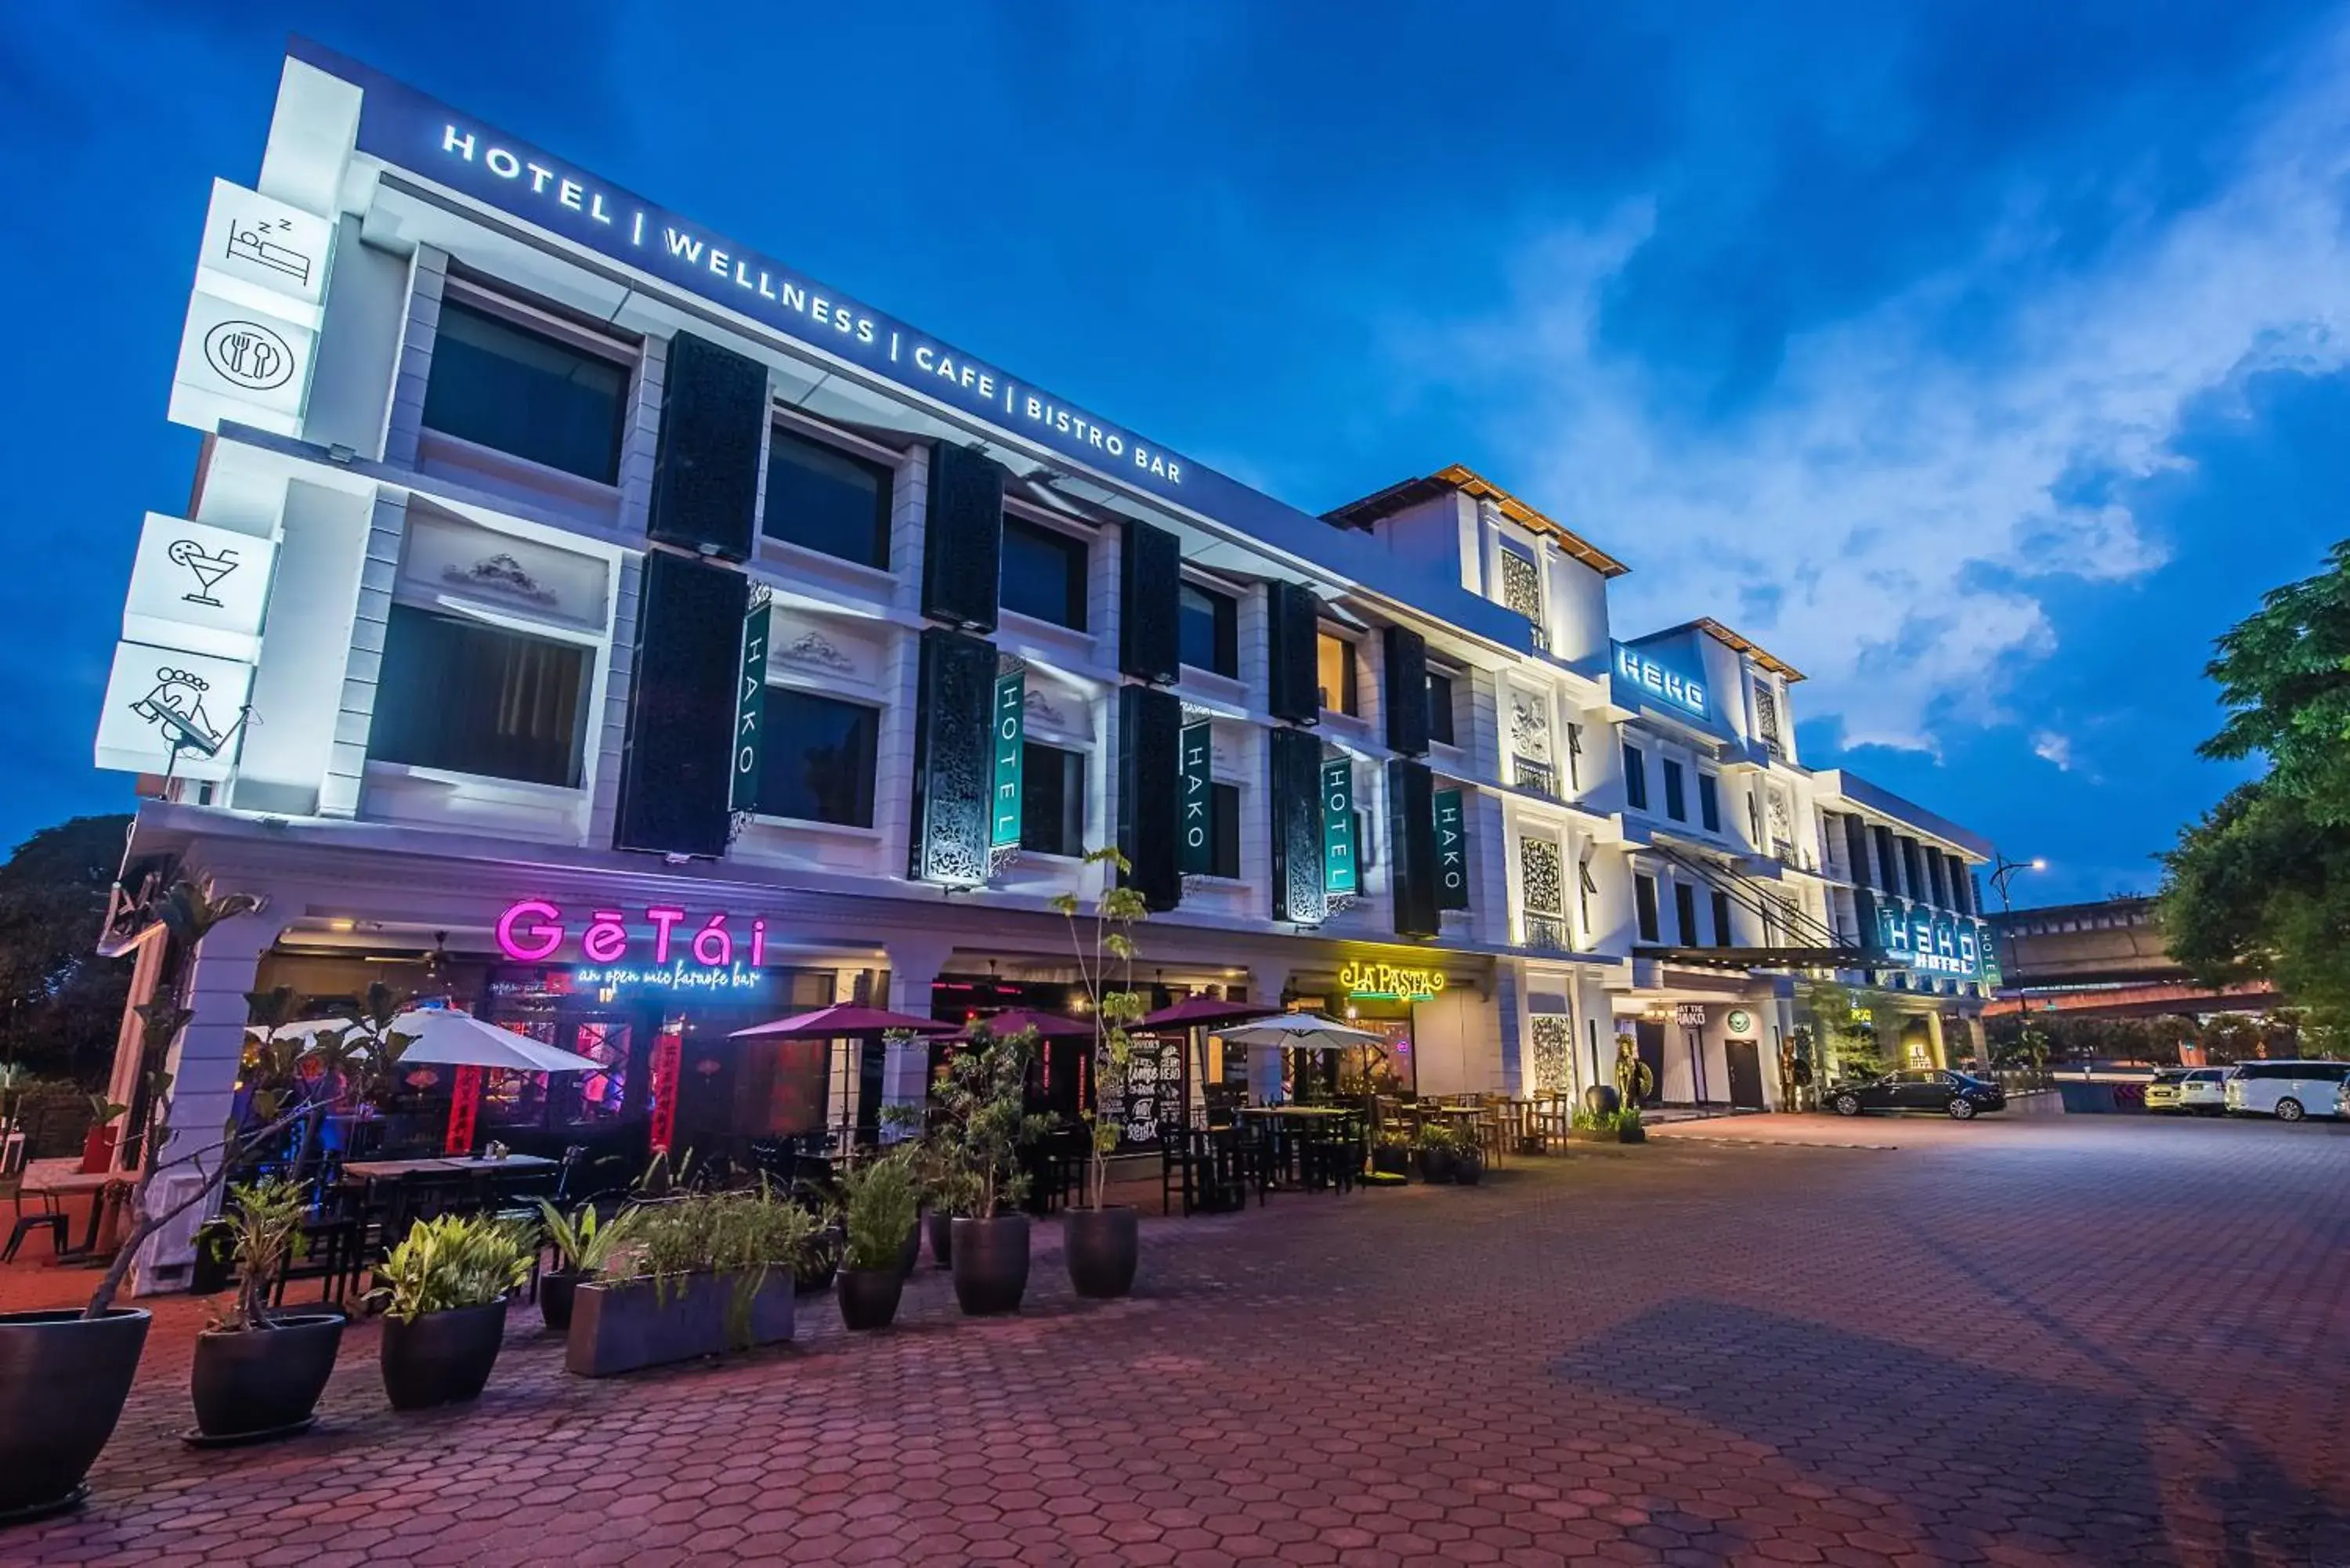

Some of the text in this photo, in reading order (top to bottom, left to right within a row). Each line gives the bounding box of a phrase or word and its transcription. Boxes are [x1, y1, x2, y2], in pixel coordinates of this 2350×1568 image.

[442, 125, 611, 225] HOTEL
[667, 227, 875, 343] WELLNESS
[915, 346, 994, 399] CAFE
[1027, 397, 1123, 456] BISTRO
[1135, 447, 1180, 483] BAR
[739, 637, 763, 773] HAKO
[998, 685, 1018, 833] HOTEL
[1188, 746, 1205, 848] HAKO
[1329, 770, 1347, 883] HOTEL
[1441, 807, 1461, 890] HAKO
[578, 969, 602, 982] an
[605, 970, 641, 993] open
[732, 960, 761, 988] bar
[1340, 962, 1444, 1002] LA PASTA
[1914, 952, 1974, 974] HOTEL
